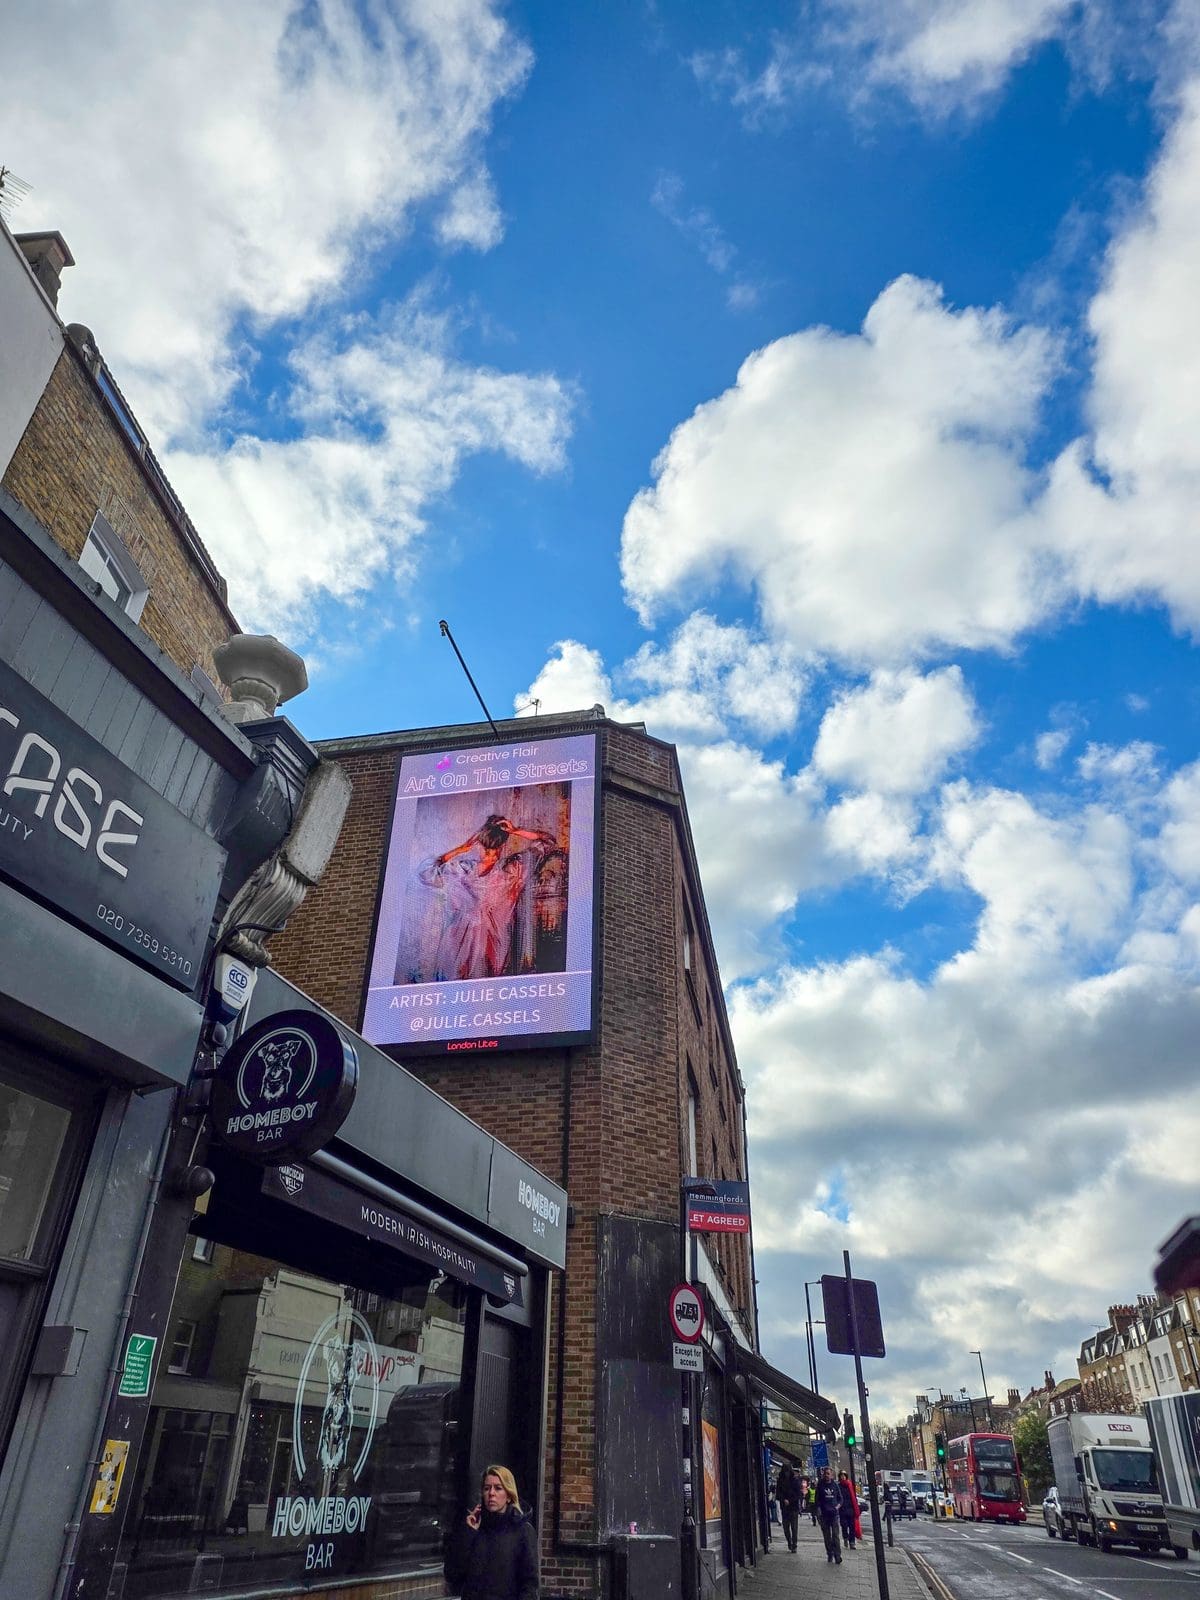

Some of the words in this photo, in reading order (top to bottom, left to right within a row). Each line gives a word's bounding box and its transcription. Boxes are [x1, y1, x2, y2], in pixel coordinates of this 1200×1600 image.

[456, 750, 510, 765] Creative
[512, 745, 539, 757] Flair
[404, 775, 435, 792] Art
[440, 772, 468, 788] On
[473, 768, 510, 784] The
[515, 758, 588, 779] Streets
[0, 707, 144, 879] ASE
[96, 904, 124, 931] 020
[127, 922, 159, 954] 7359
[161, 946, 192, 975] 5310
[229, 969, 248, 989] ACE
[389, 992, 447, 1009] ARTIST:
[450, 988, 494, 1004] JULIE
[499, 983, 566, 1000] CASSELS
[410, 1009, 541, 1032] @JULIE.CASSELS
[447, 1041, 476, 1050] London
[226, 1101, 318, 1134] HOMEBOY
[256, 1127, 283, 1142] BAR
[518, 1179, 561, 1227] HOMEBOY
[532, 1217, 546, 1239] BAR
[706, 1215, 746, 1227] AGREED
[361, 1206, 404, 1236] MODERN
[406, 1226, 430, 1248] IRISH
[431, 1241, 476, 1275] HOSPITALITY
[674, 1345, 693, 1358] Except
[693, 1349, 702, 1358] for
[679, 1358, 698, 1368] access
[272, 1496, 372, 1538] HOMEBOY
[305, 1542, 334, 1570] BAR
